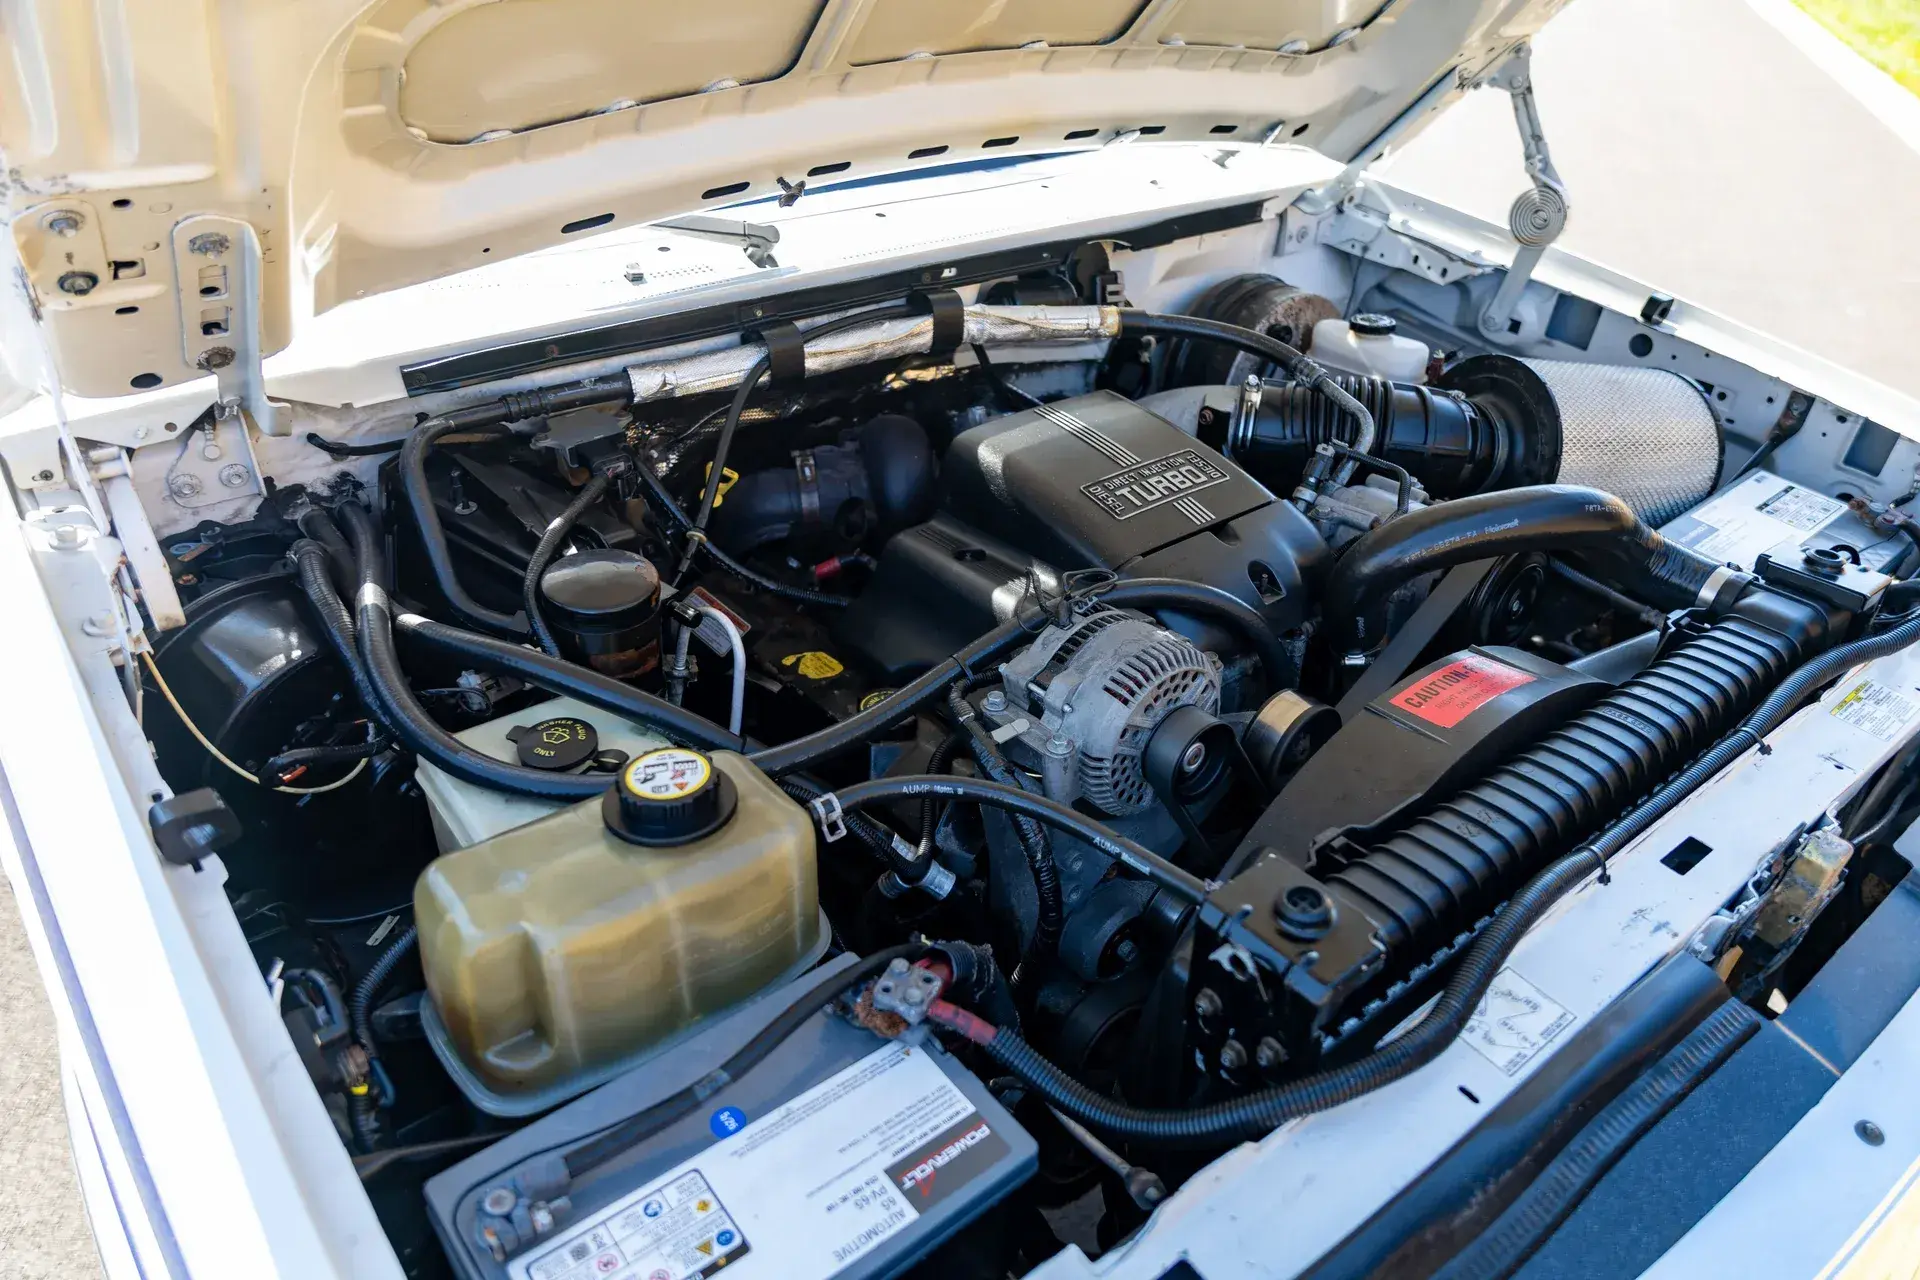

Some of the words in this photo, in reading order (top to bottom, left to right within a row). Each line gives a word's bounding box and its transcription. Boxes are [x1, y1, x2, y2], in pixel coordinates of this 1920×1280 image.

[1103, 473, 1140, 490] DIRECT
[1138, 456, 1185, 478] INJECTION
[1186, 453, 1222, 480] DIESEL
[1088, 485, 1127, 515] DIESEL
[1115, 465, 1209, 507] TURBO
[574, 723, 587, 740] FLUID
[533, 747, 556, 757] ONLY
[902, 1123, 991, 1191] POWERVOLT
[832, 1206, 907, 1262] AUTOMOTIVE
